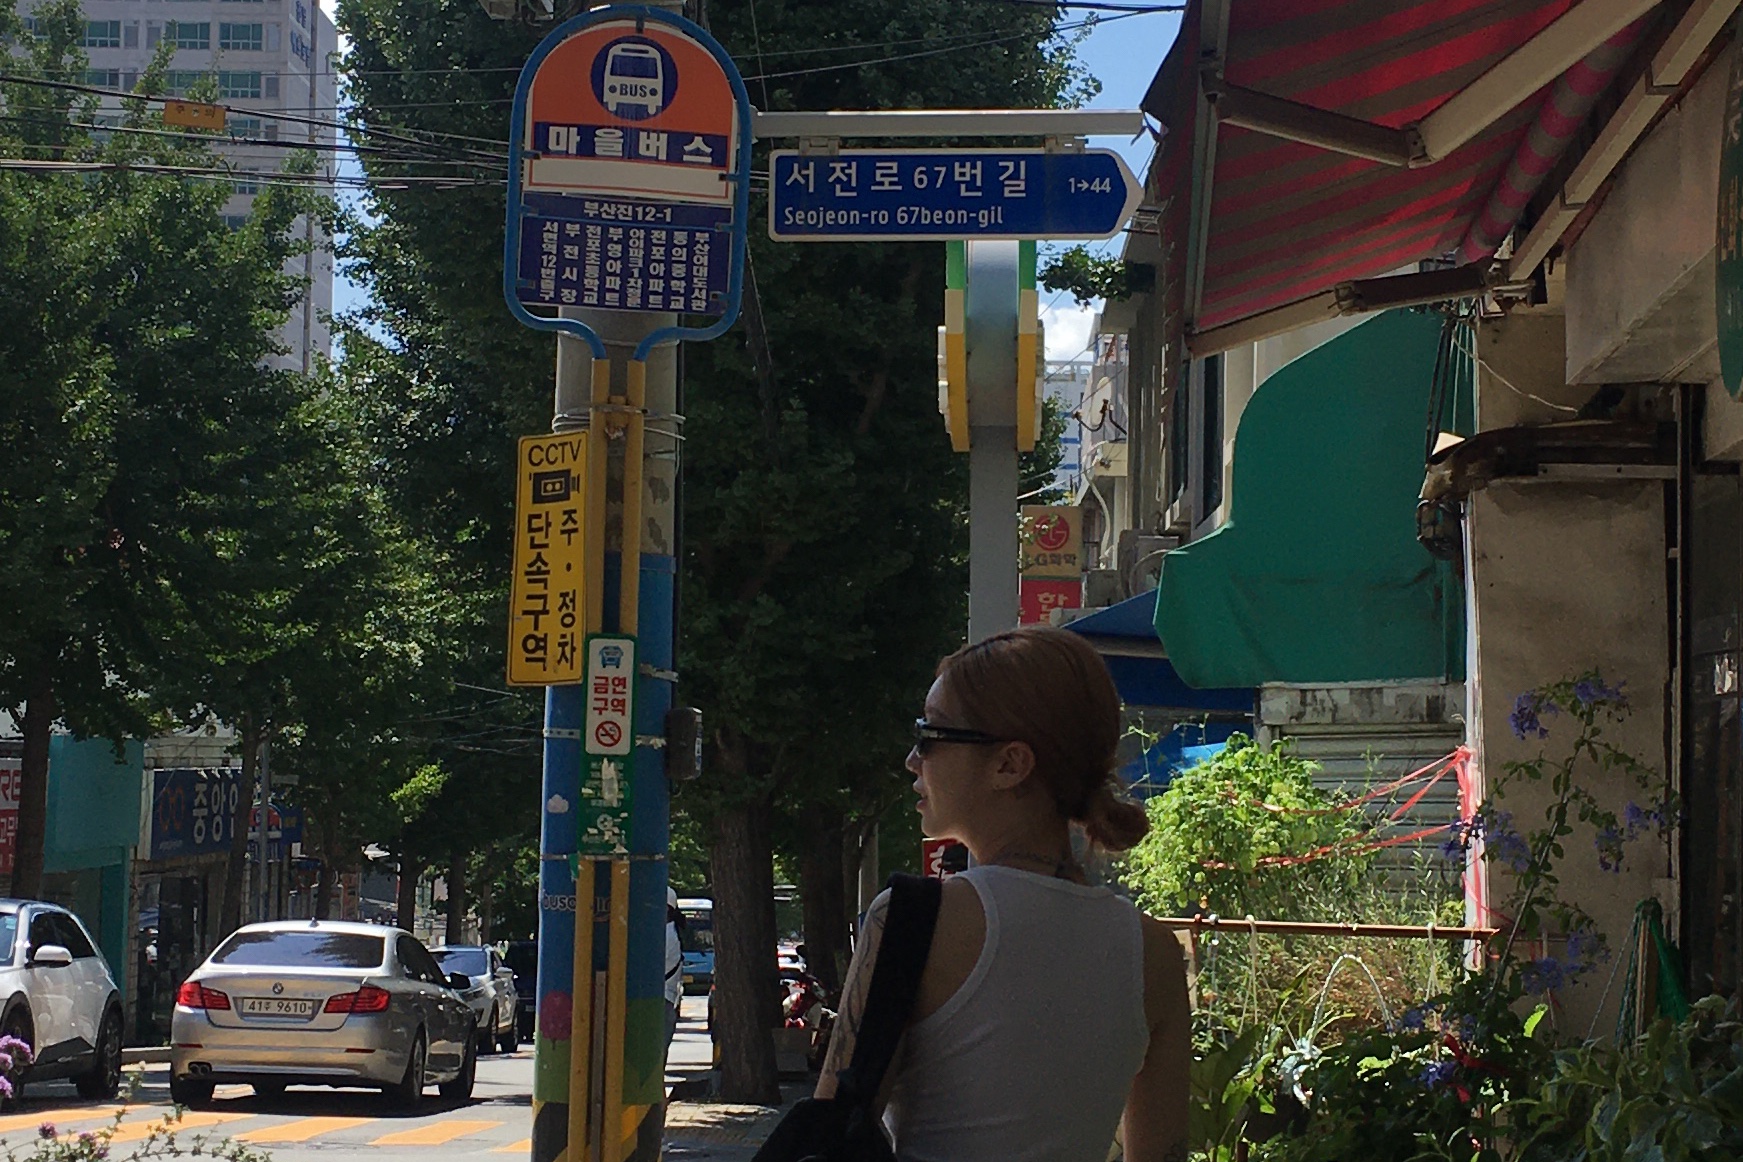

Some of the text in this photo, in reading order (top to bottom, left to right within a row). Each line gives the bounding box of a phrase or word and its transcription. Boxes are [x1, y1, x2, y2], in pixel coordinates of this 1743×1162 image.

[619, 83, 647, 98] BUS
[548, 126, 713, 164] 마을버스
[584, 202, 672, 222] 부산진12-1
[784, 206, 1003, 228] Seojeon-ro 67beon-gil
[560, 223, 581, 303] 부전시장
[527, 440, 582, 466] CCTV
[521, 511, 552, 671] 단속구역
[593, 675, 627, 695] 금연
[592, 698, 626, 717] 구역
[277, 1001, 306, 1013] 9610
